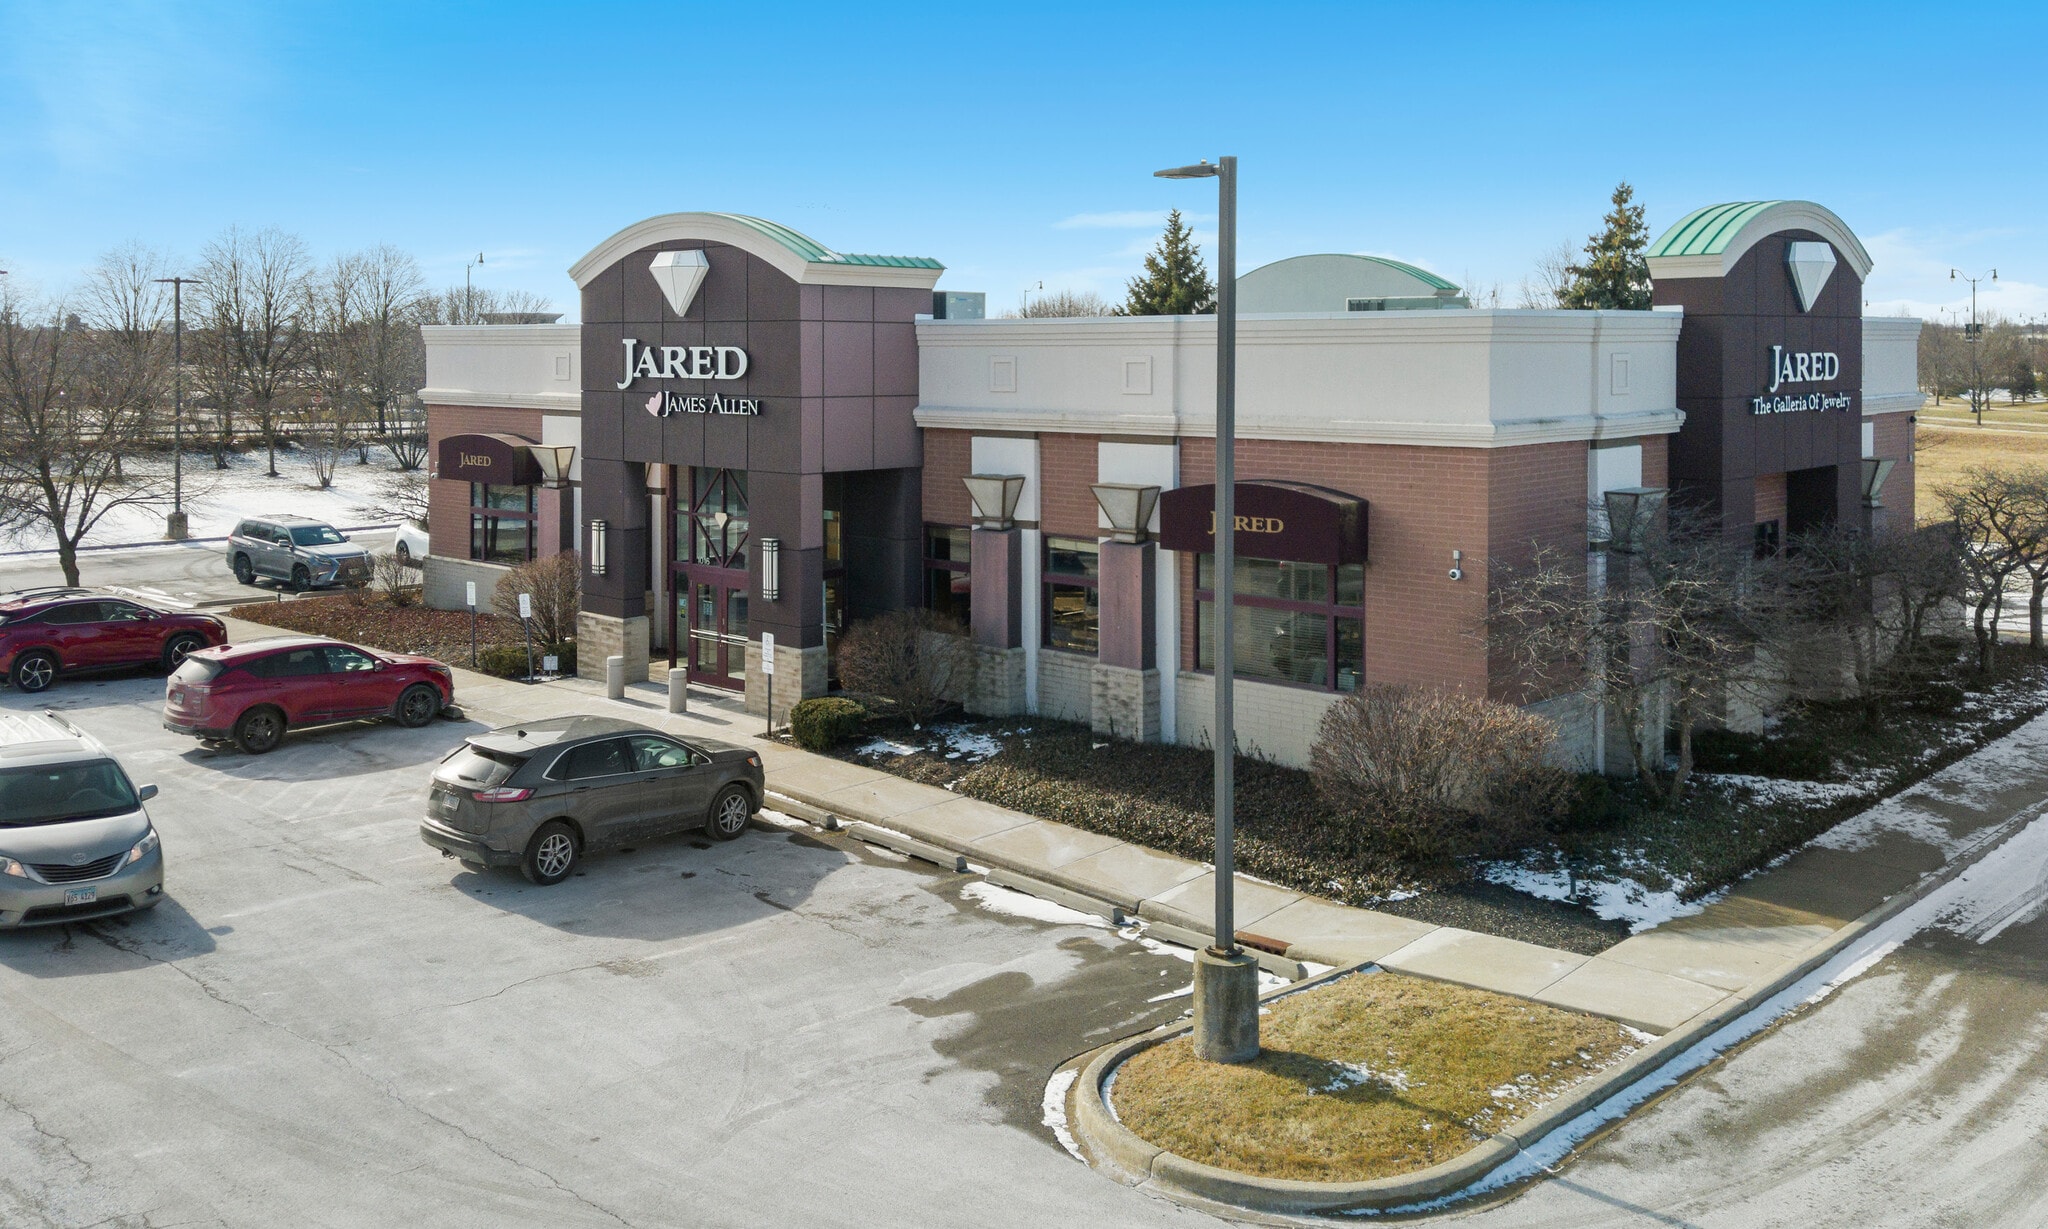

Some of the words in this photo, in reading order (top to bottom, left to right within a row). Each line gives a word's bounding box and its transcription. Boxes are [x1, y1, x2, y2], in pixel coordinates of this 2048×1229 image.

[617, 338, 748, 390] JARED
[1769, 345, 1840, 393] JARED
[662, 390, 706, 418] JAMES
[709, 392, 759, 415] ALLEN
[1753, 396, 1771, 415] The
[1773, 395, 1807, 413] Galleria
[1808, 392, 1820, 410] Of
[1820, 392, 1851, 413] Jewelry
[459, 451, 492, 468] JARED
[1208, 510, 1284, 535] JRED
